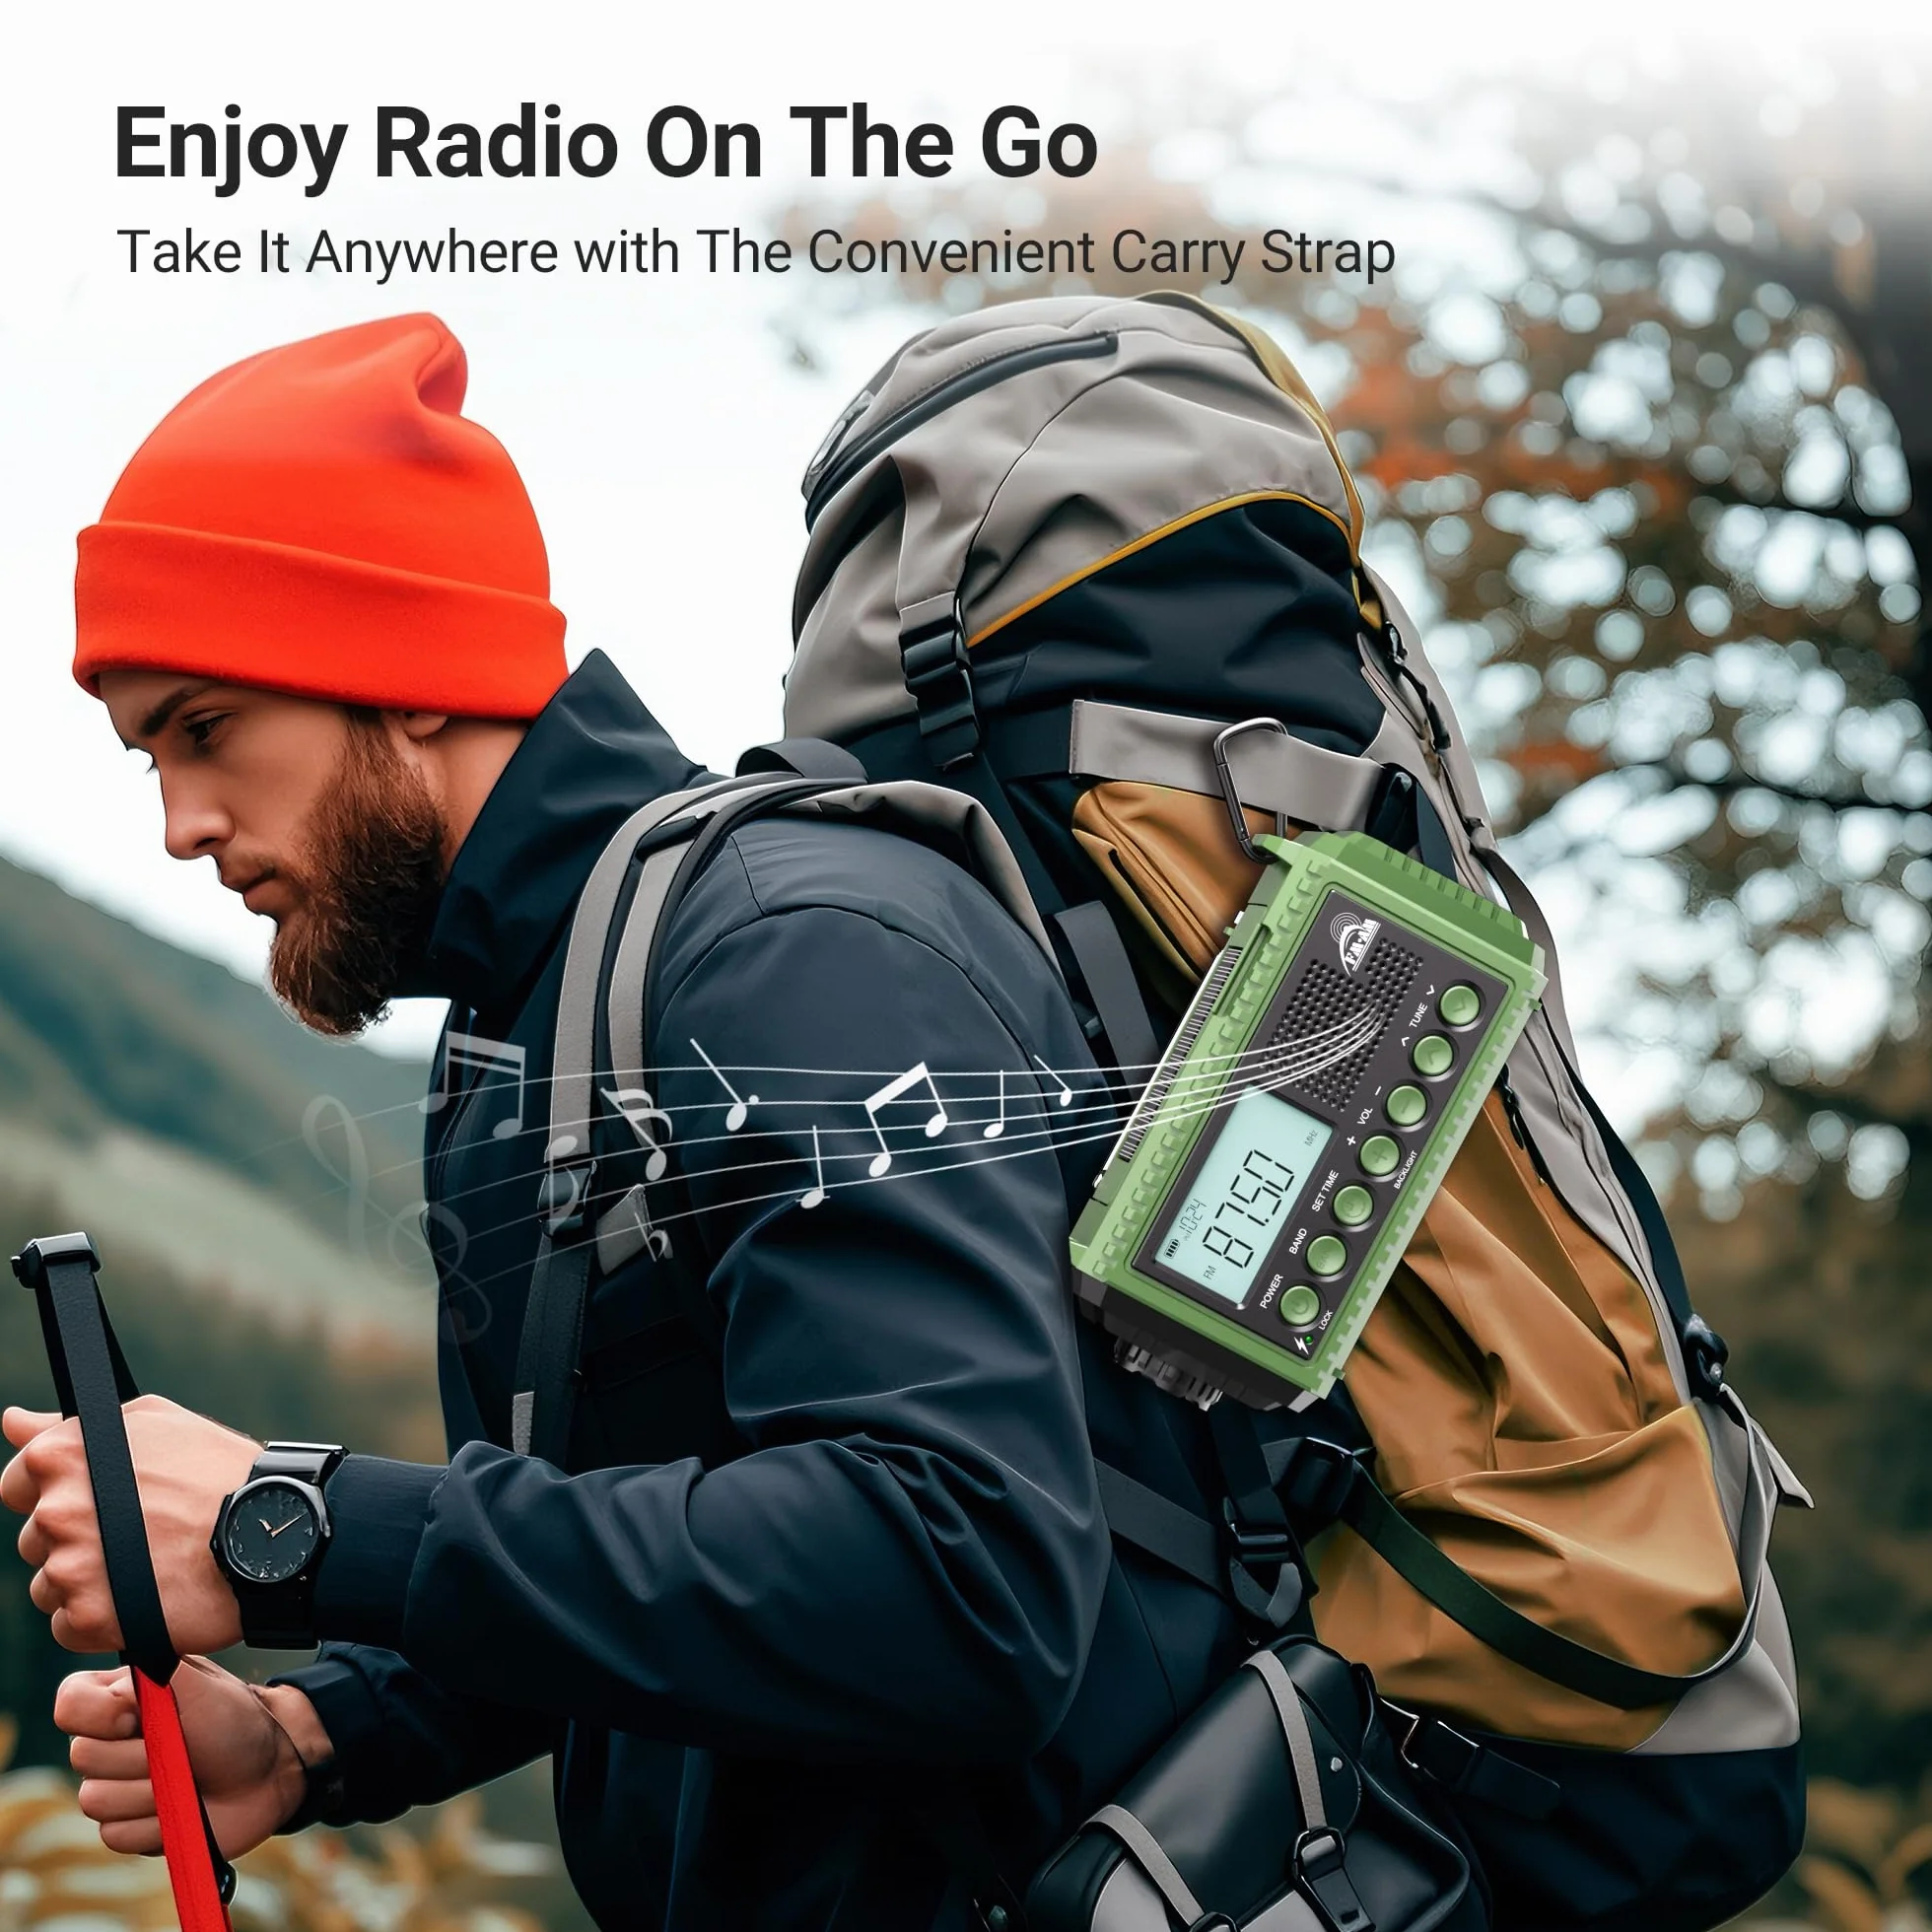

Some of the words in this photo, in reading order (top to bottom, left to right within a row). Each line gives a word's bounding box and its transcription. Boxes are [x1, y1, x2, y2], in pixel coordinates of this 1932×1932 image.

[1409, 1001, 1428, 1029] TUNE
[1356, 1106, 1374, 1127] VOL
[1304, 1130, 1319, 1146] MHz
[1393, 1149, 1418, 1191] BACKLIGHT
[1311, 1192, 1327, 1212] SET
[1321, 1169, 1340, 1193] TIME
[1202, 1149, 1295, 1269] 87.50
[1288, 1227, 1308, 1255] BAND
[1203, 1265, 1217, 1280] FM
[1260, 1274, 1284, 1309] POWER
[1318, 1309, 1334, 1331] LOCK
